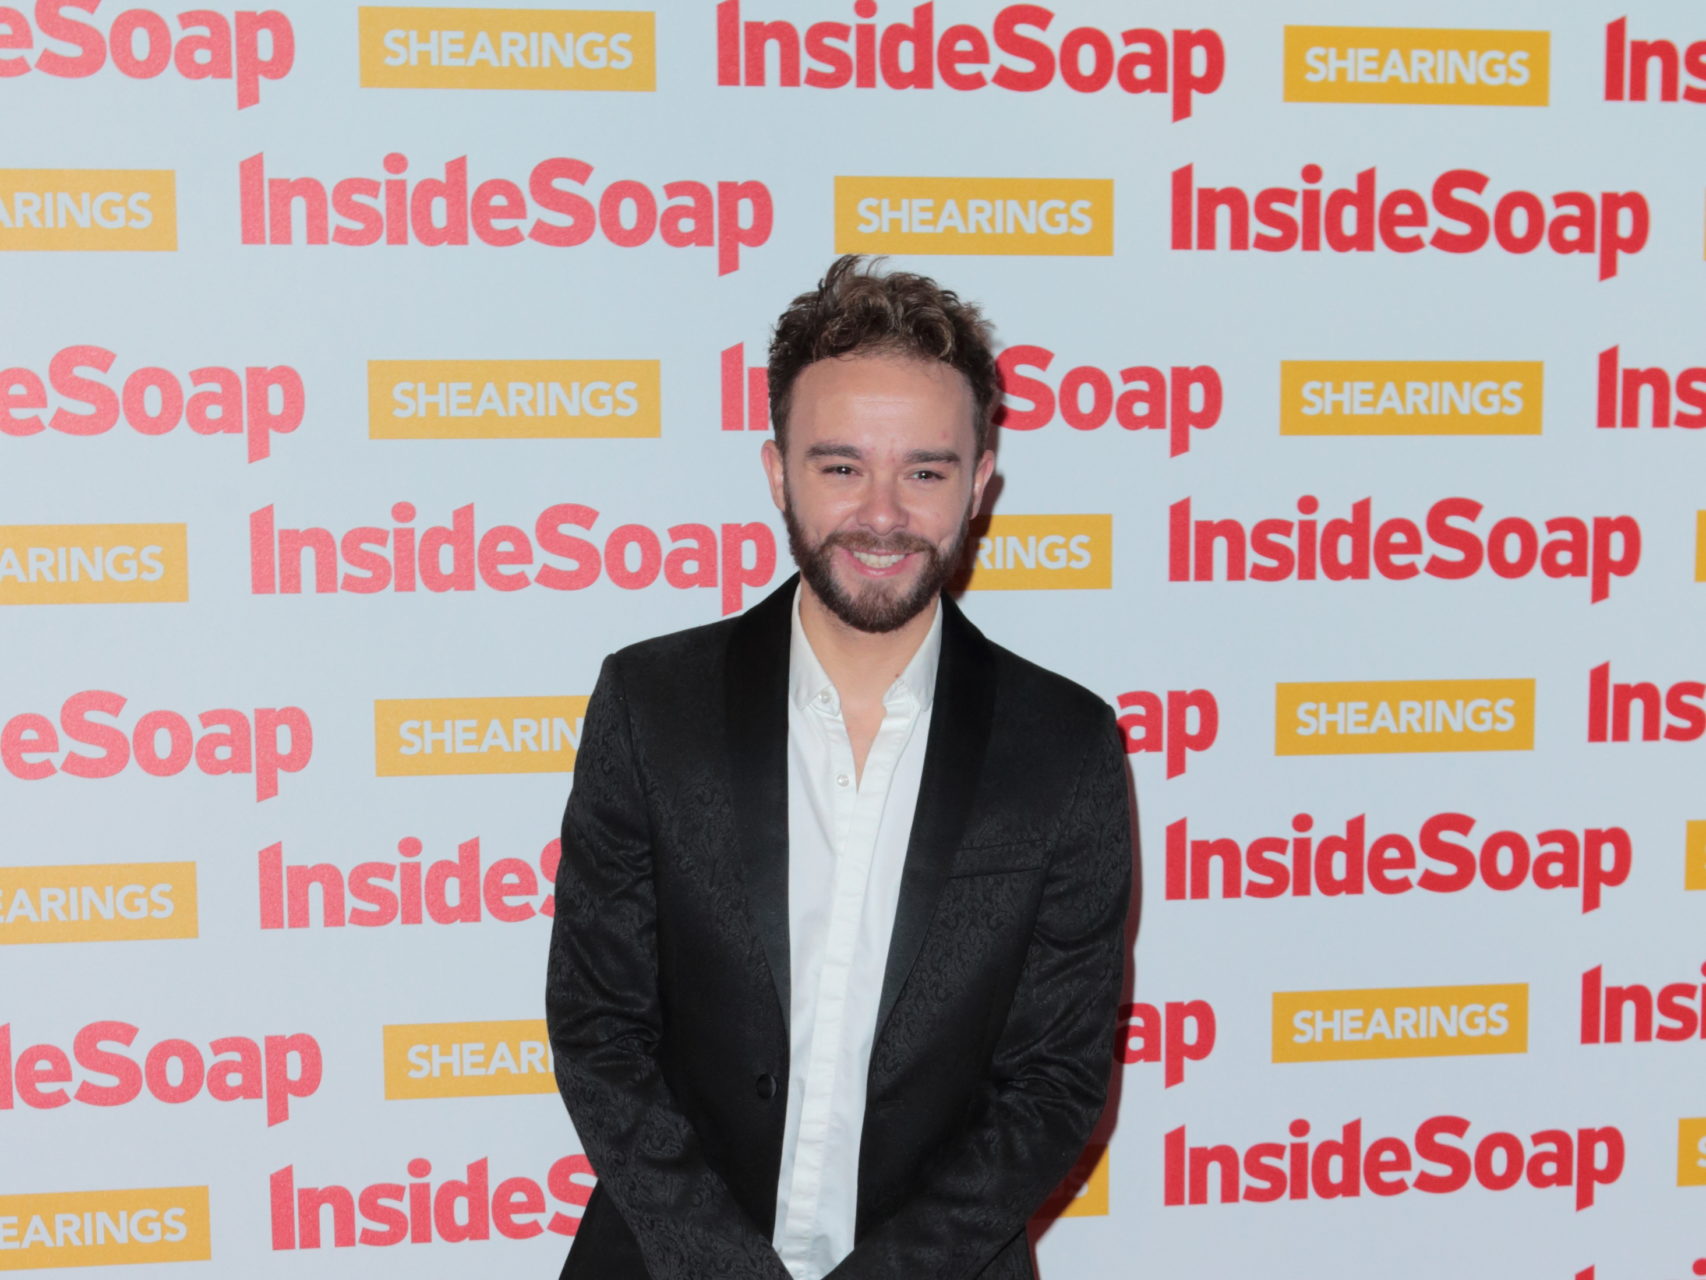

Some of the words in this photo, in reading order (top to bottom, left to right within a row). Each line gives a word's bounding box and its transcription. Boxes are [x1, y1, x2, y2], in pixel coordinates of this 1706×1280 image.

[0, 0, 294, 109] eSoap
[383, 29, 633, 70] SHEARINGS
[717, 0, 1225, 122] InsideSoap
[1306, 47, 1529, 85] SHEARINGS
[0, 192, 153, 229] RINGS
[240, 153, 773, 276] InsideSoap
[857, 198, 1092, 235] SHEARINGS
[1171, 164, 1650, 281] InsideSoap
[0, 346, 304, 462] eSoap
[392, 381, 639, 418] SHEARINGS
[1302, 381, 1523, 415] SHEARINGS
[0, 544, 165, 583] ARINGS
[250, 502, 776, 615] InsideSoap
[978, 534, 1091, 570] RINGS
[1169, 496, 1641, 603] InsideSoap
[399, 717, 584, 755] SHEARIN
[1297, 698, 1515, 736] SHEARINGS
[0, 691, 312, 801] eSoap
[259, 838, 562, 929] Inside
[1165, 813, 1632, 913] InsideSoap
[0, 883, 175, 924] ARINGS
[1293, 1003, 1508, 1043] SHEARINGS
[0, 1021, 322, 1126] eSoap
[407, 1039, 554, 1079] SHEARI
[1164, 1115, 1625, 1211] InsideSoap
[270, 1154, 596, 1250] InsideS
[0, 1208, 187, 1250] EARINGS
